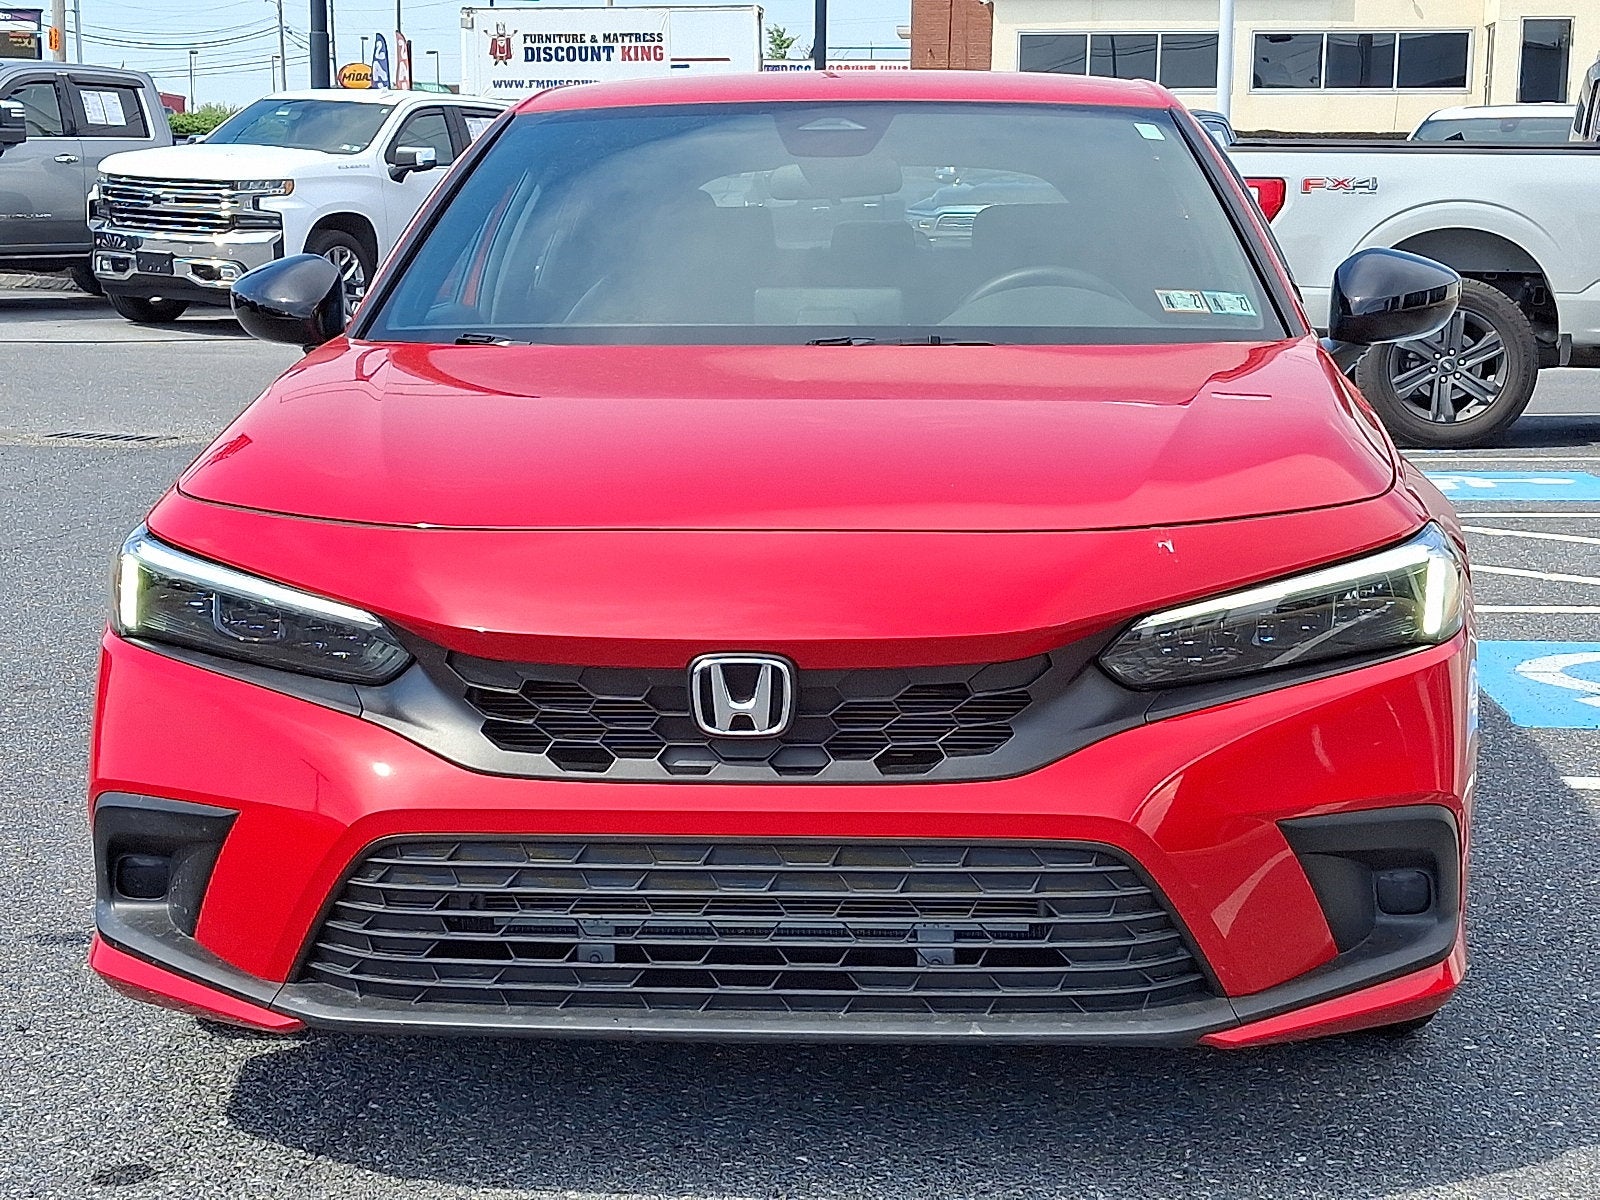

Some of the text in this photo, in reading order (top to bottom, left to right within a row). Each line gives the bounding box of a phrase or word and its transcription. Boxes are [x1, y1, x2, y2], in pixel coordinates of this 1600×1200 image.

[523, 32, 664, 44] FURNITURE & MATTRESS
[523, 45, 664, 63] DISCOUNT KING
[342, 72, 372, 82] MIDA
[1300, 177, 1378, 194] FX4
